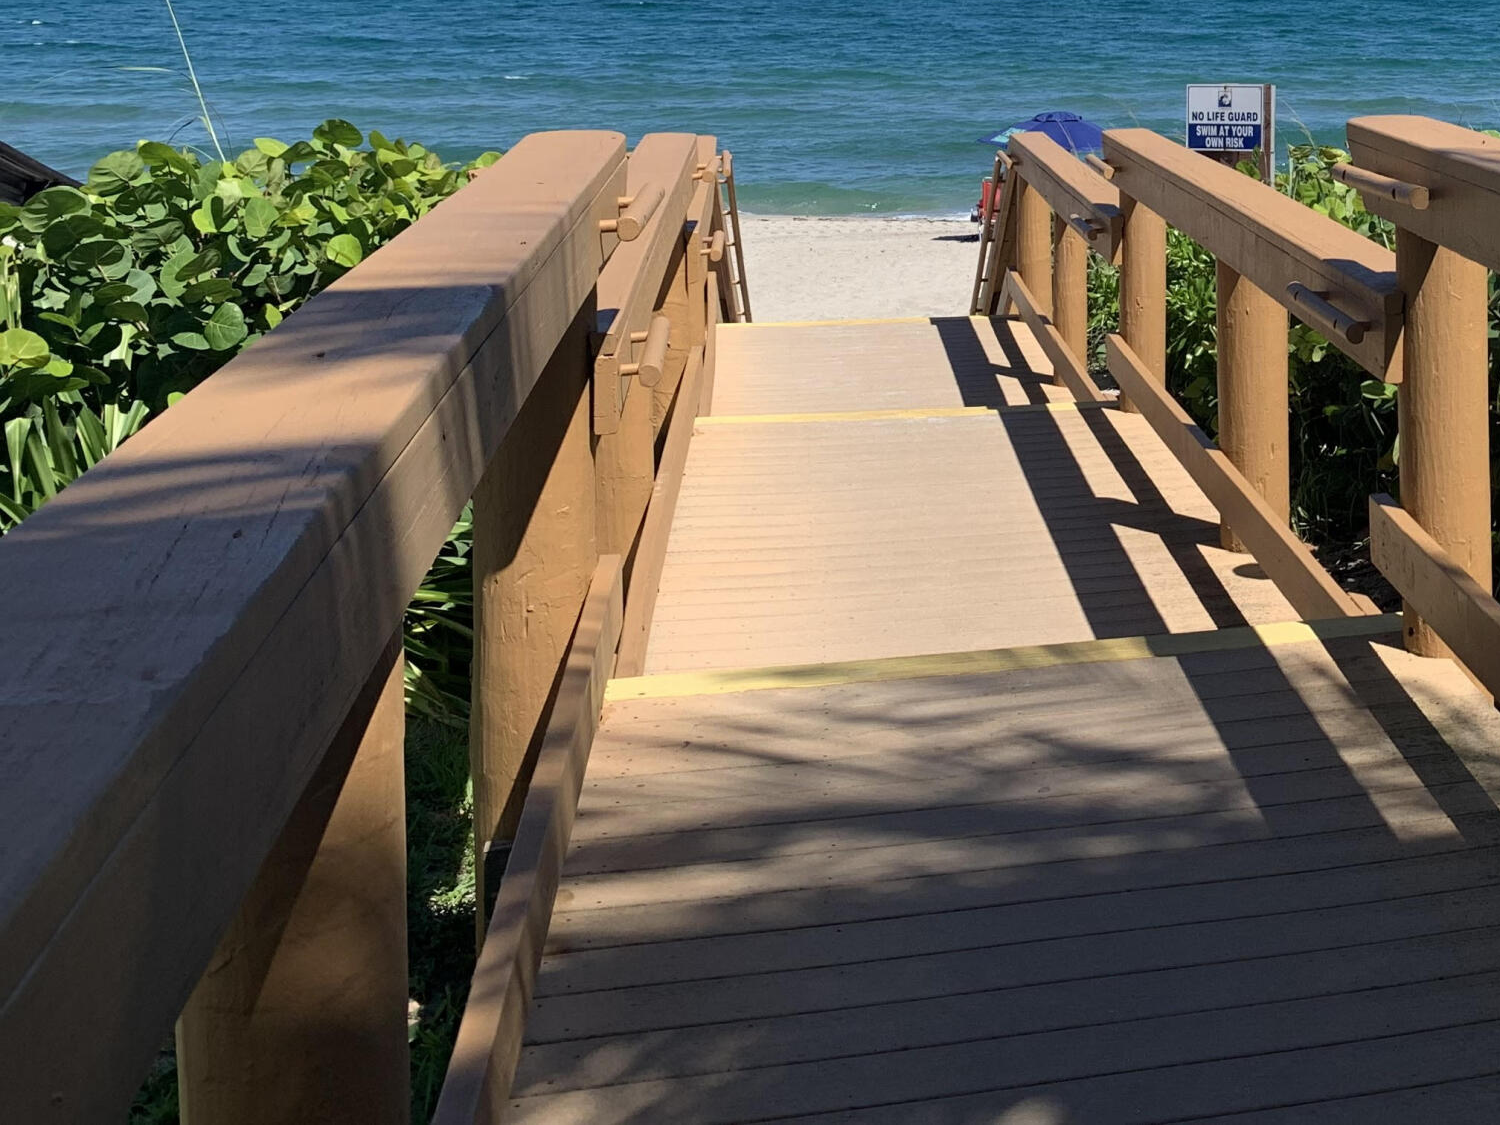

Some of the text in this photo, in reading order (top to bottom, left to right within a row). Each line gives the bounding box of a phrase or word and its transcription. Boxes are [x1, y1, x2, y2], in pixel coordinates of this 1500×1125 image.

[1192, 112, 1258, 121] NO LIFE GUARD
[1196, 125, 1253, 136] SWIM AT YOUR
[1205, 138, 1244, 147] OWN RISK
